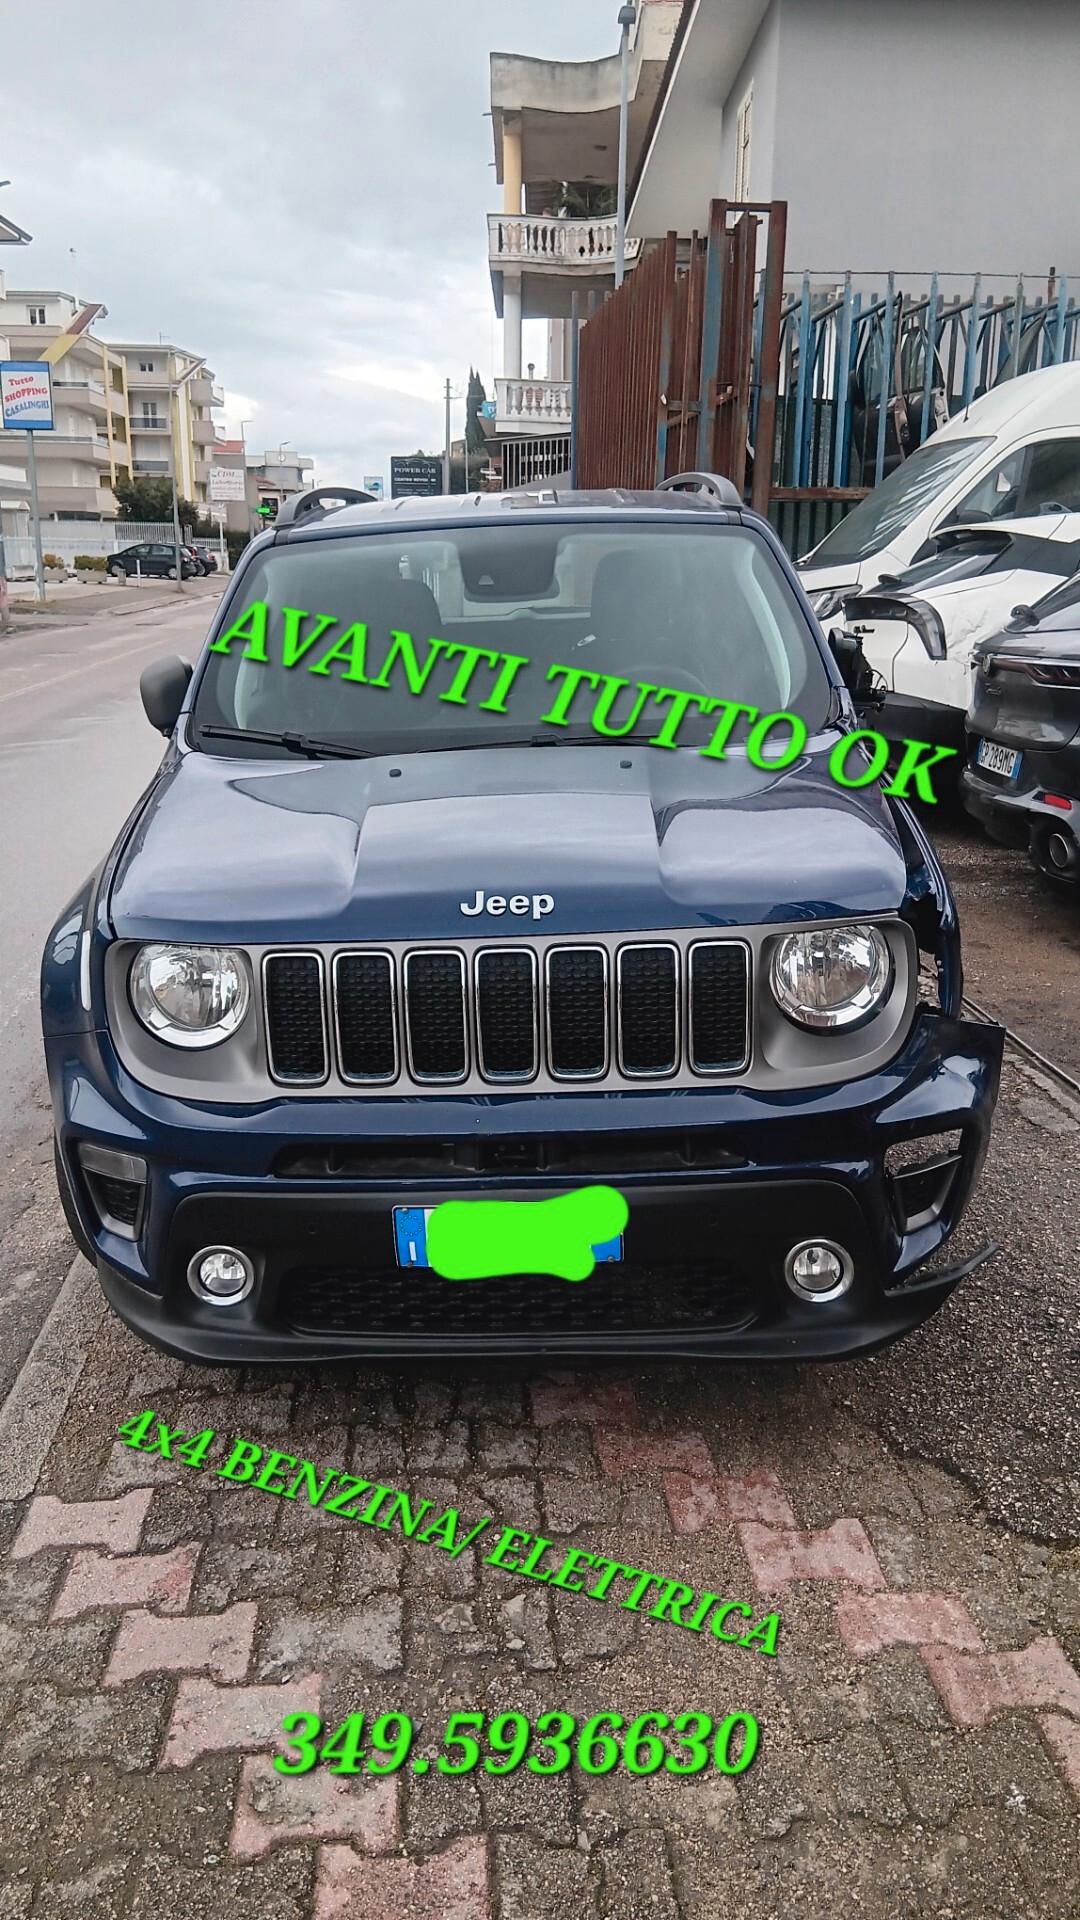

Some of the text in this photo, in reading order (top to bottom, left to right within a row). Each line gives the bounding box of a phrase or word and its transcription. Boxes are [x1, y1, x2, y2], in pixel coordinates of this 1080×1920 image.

[8, 376, 34, 386] Tutto
[4, 387, 49, 402] SHOPPING
[5, 400, 50, 417] CASALINGHI
[460, 890, 555, 920] Jeep
